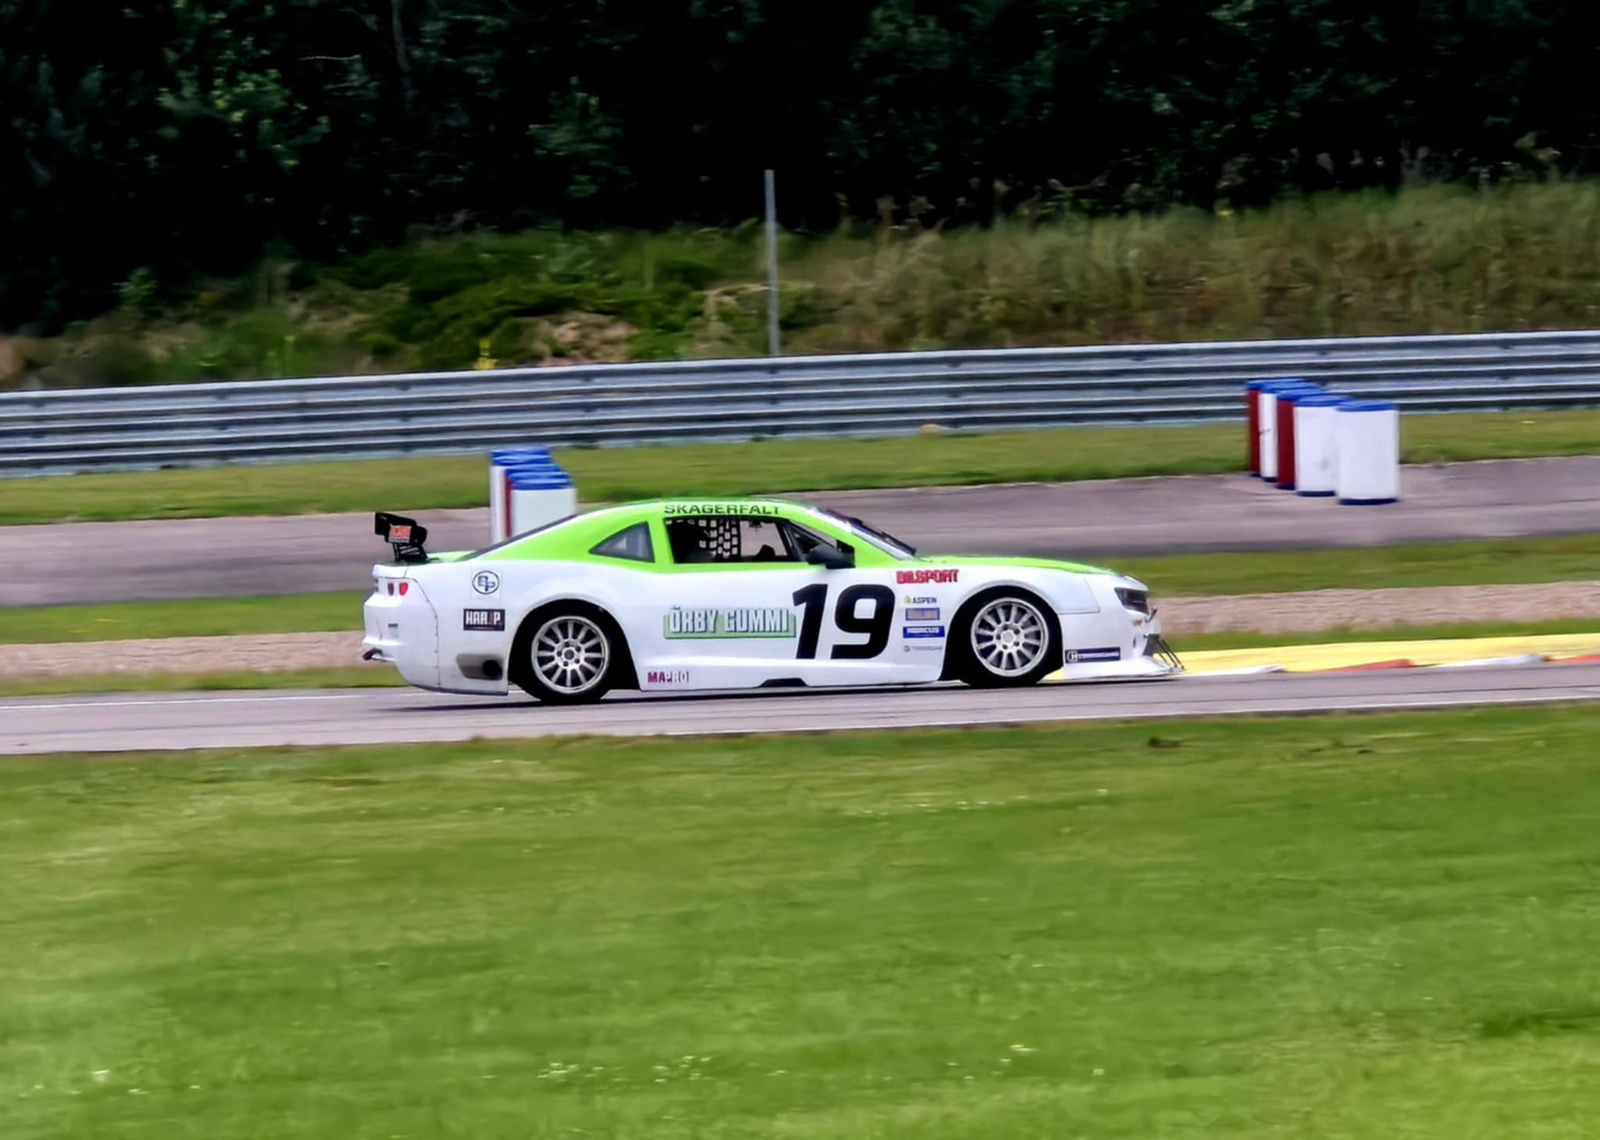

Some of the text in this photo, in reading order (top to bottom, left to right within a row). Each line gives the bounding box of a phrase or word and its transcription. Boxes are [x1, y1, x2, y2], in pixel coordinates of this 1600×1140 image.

[896, 569, 959, 584] BILSPORT
[670, 606, 789, 633] ÖRBY GUMMI
[792, 583, 896, 660] 19
